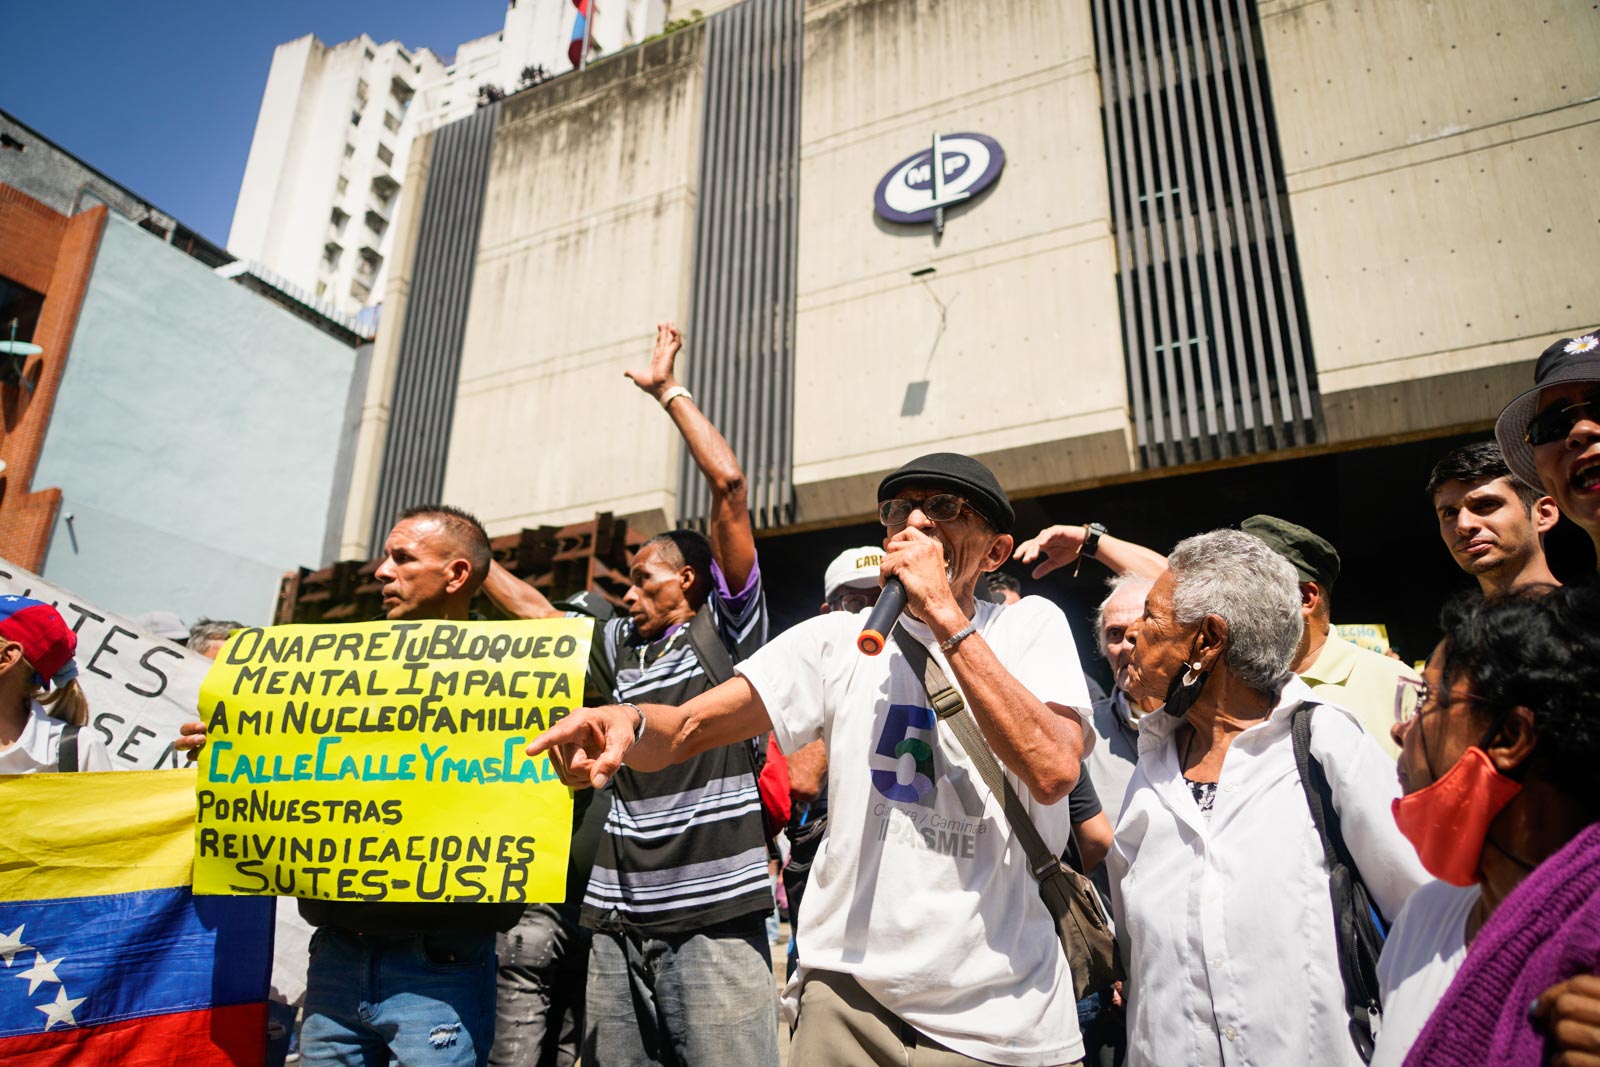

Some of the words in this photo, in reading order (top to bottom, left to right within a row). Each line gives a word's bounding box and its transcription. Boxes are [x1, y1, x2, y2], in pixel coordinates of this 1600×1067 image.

[855, 554, 883, 569] CAR
[233, 666, 388, 696] MENTAL
[395, 663, 571, 698] IMPACTA
[207, 701, 229, 734] A
[281, 701, 420, 734] NUCLEO
[208, 741, 313, 784] CALLE
[315, 737, 416, 783] CALLE
[502, 737, 561, 784] CAL
[199, 828, 536, 864] REIVINDICACIONES
